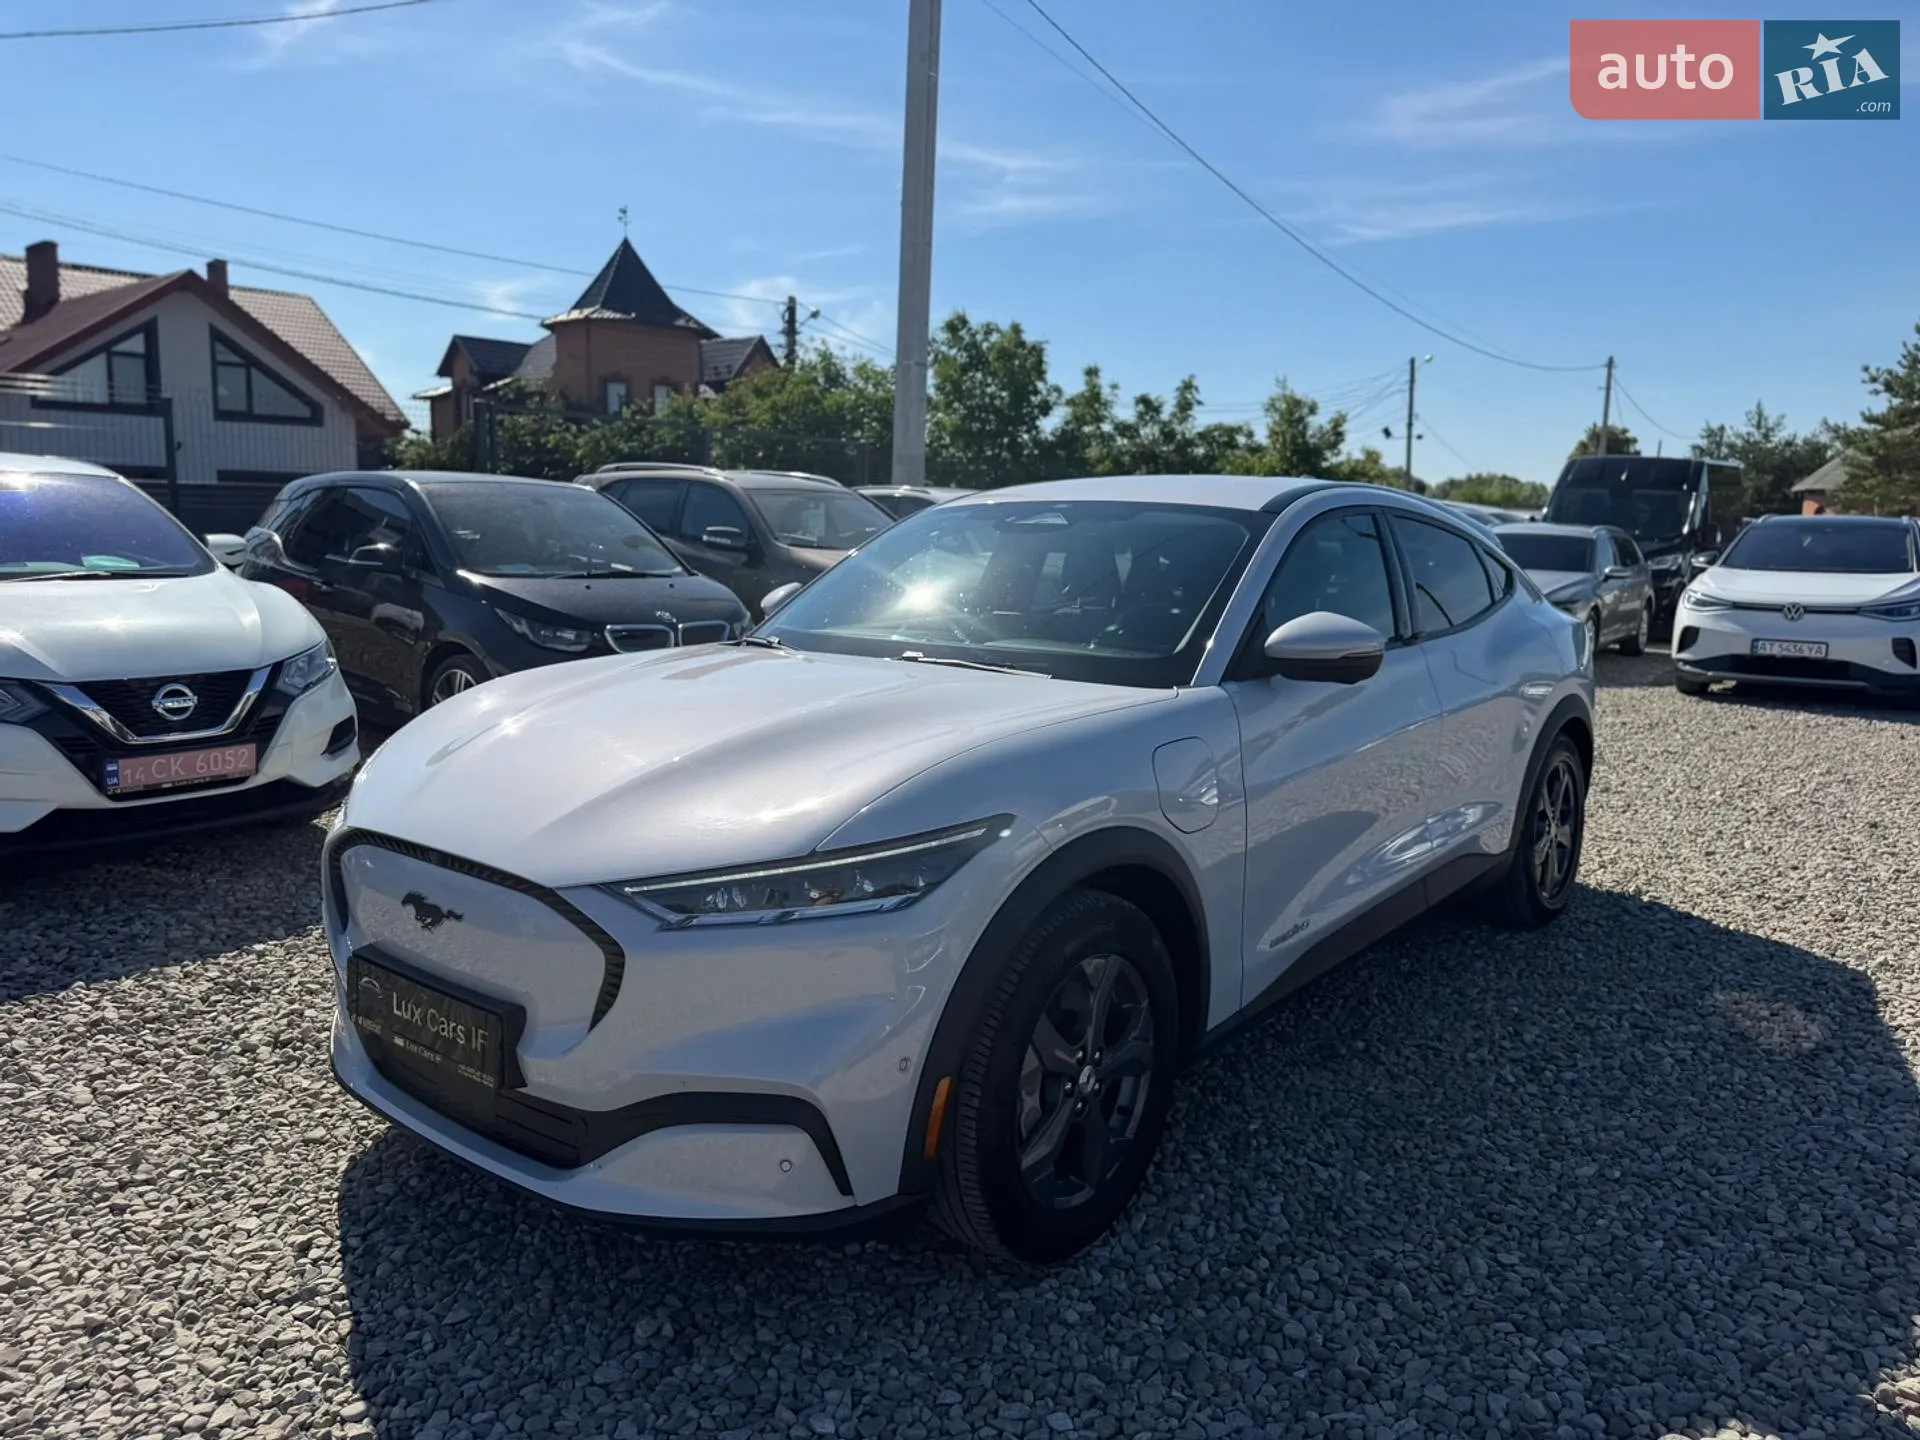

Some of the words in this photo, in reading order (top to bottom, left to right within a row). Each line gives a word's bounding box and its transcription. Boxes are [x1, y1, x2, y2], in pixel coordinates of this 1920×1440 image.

[1758, 641, 1774, 653] AT
[123, 767, 145, 784] 14
[151, 756, 187, 779] CK
[195, 748, 249, 773] 6052
[106, 777, 119, 785] UA
[393, 992, 422, 1026] Lux
[426, 1008, 466, 1045] Cars
[471, 1026, 489, 1052] IF
